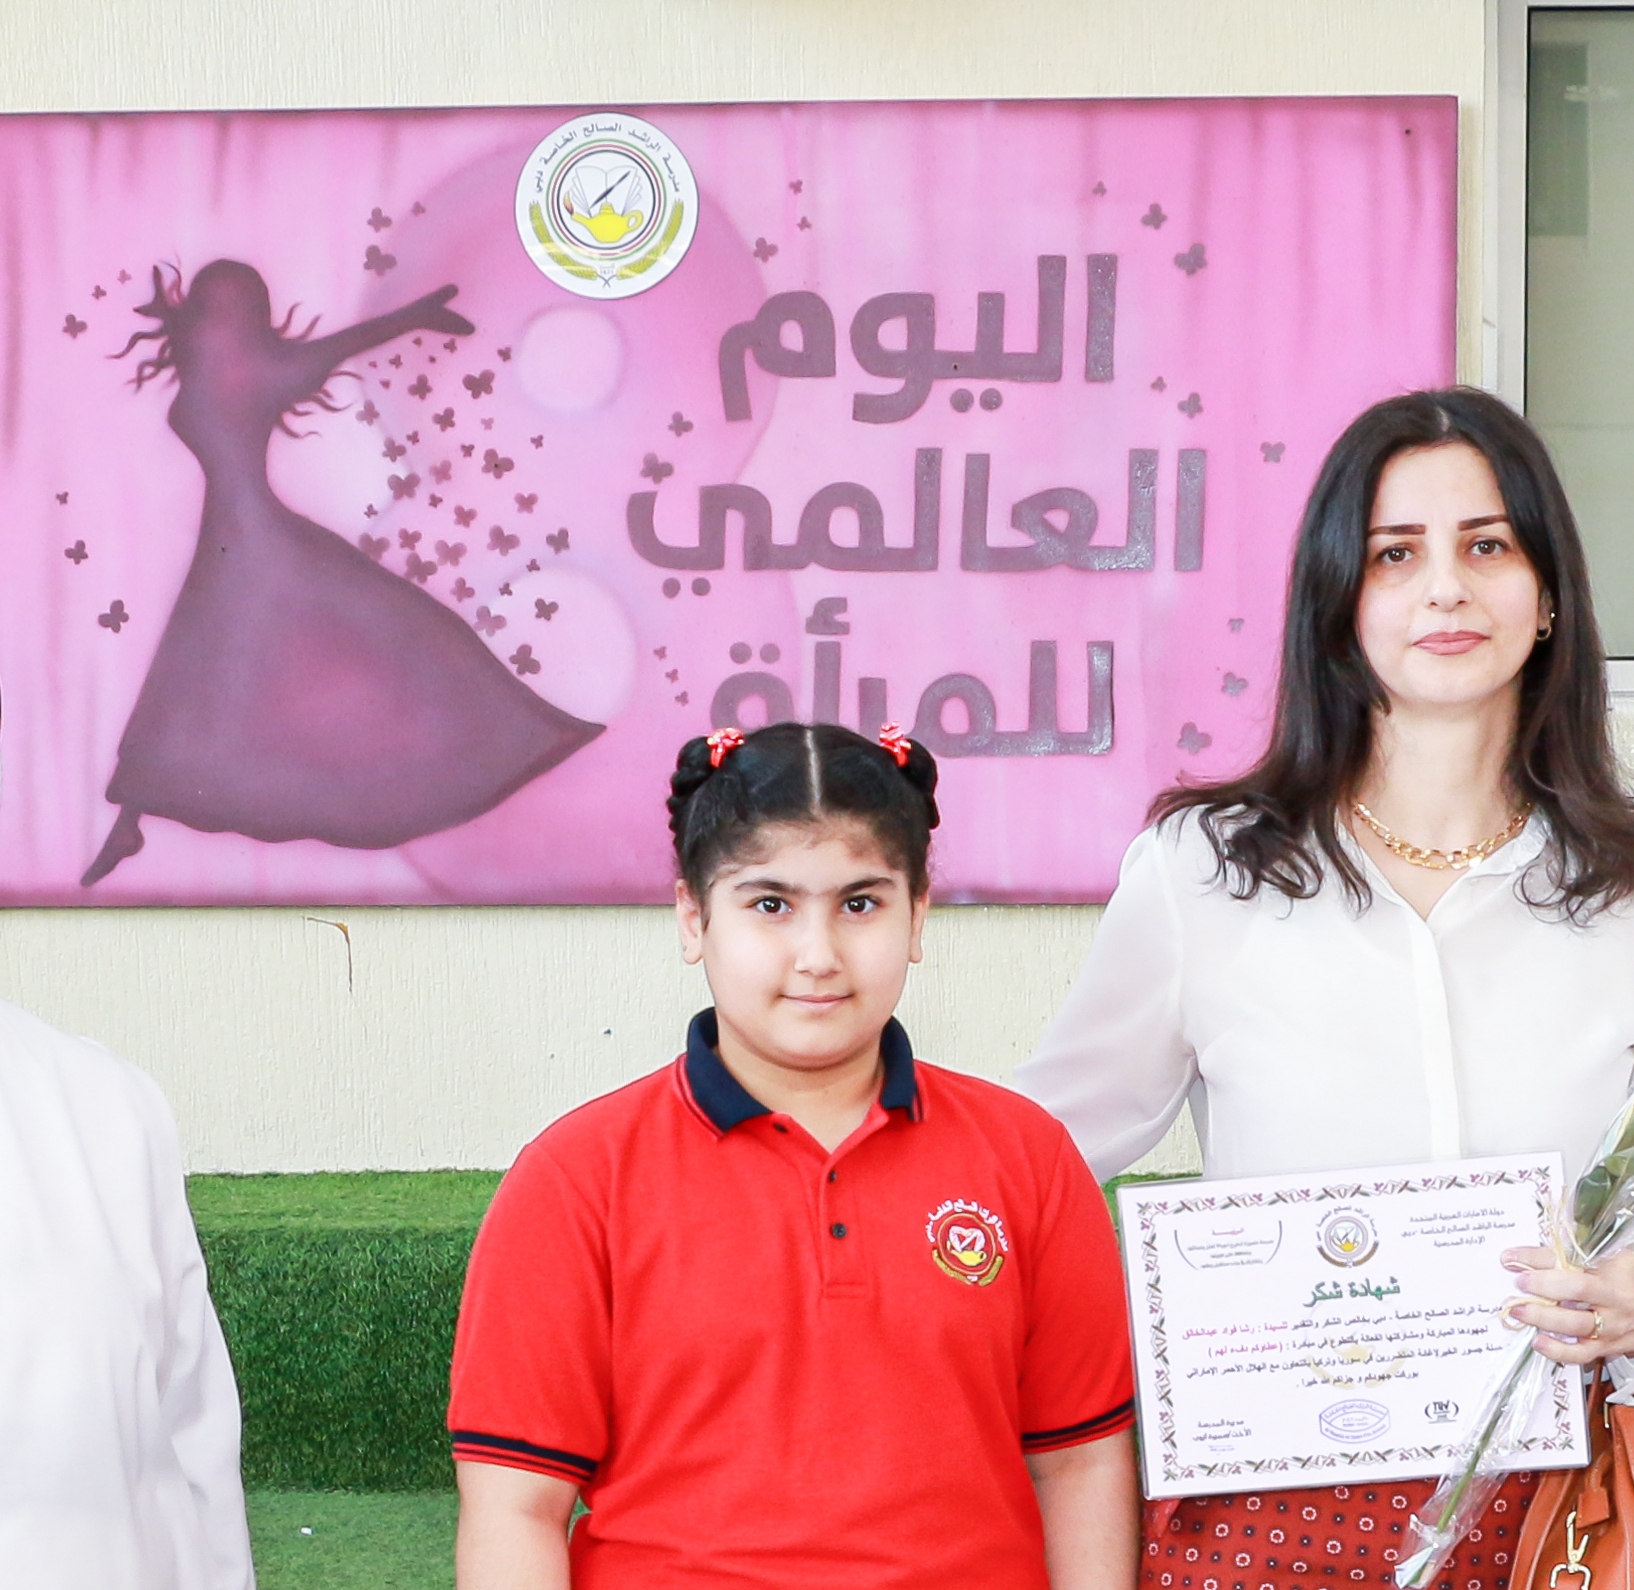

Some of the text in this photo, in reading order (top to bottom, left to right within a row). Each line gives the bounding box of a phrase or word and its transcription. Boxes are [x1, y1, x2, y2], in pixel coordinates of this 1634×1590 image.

[535, 122, 680, 193] مدرسة الراشد الصالح الخاصة دبي
[718, 253, 1118, 424] اليوم
[626, 447, 1207, 598] العالمي
[1302, 1276, 1400, 1307] شهادة شكر
[1395, 1310, 1422, 1320] الخاصة
[1424, 1308, 1449, 1321] الصالح
[1453, 1306, 1475, 1316] الراشد
[1322, 1317, 1341, 1328] الشكر
[1345, 1316, 1370, 1326] بخالص
[1372, 1315, 1386, 1324] دبي
[1426, 1328, 1454, 1338] المباركة
[1457, 1325, 1488, 1336] لجهودها
[1318, 1338, 1327, 1348] في
[1246, 1363, 1266, 1374] الهلال
[1269, 1363, 1279, 1373] مع
